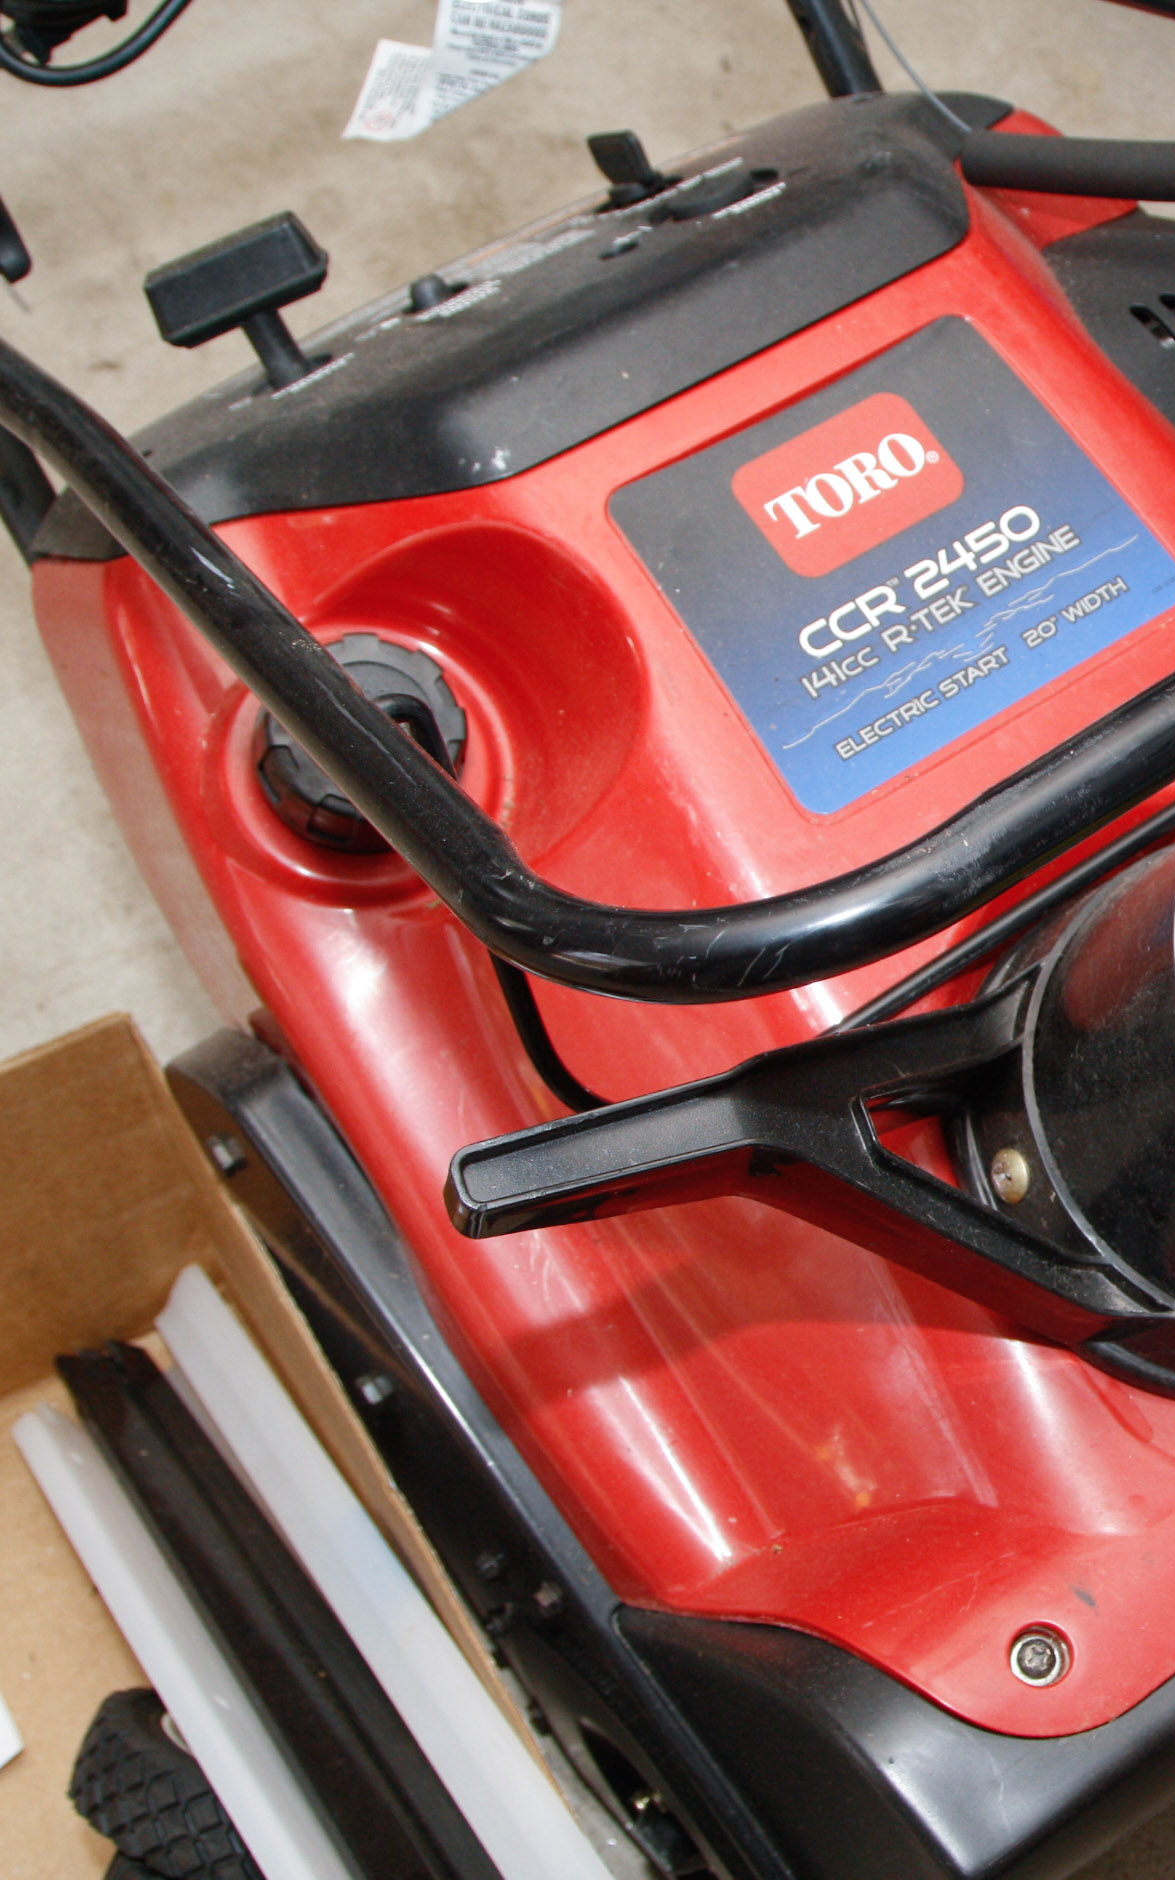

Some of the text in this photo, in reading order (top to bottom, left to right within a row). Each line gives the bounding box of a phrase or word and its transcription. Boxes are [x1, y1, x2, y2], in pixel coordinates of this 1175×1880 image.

[905, 506, 1039, 598] 2450
[977, 526, 1079, 595] ENGINE
[836, 691, 938, 758] ELECTRIC
[939, 647, 1007, 697] START
[1062, 578, 1127, 622] WIDTH
